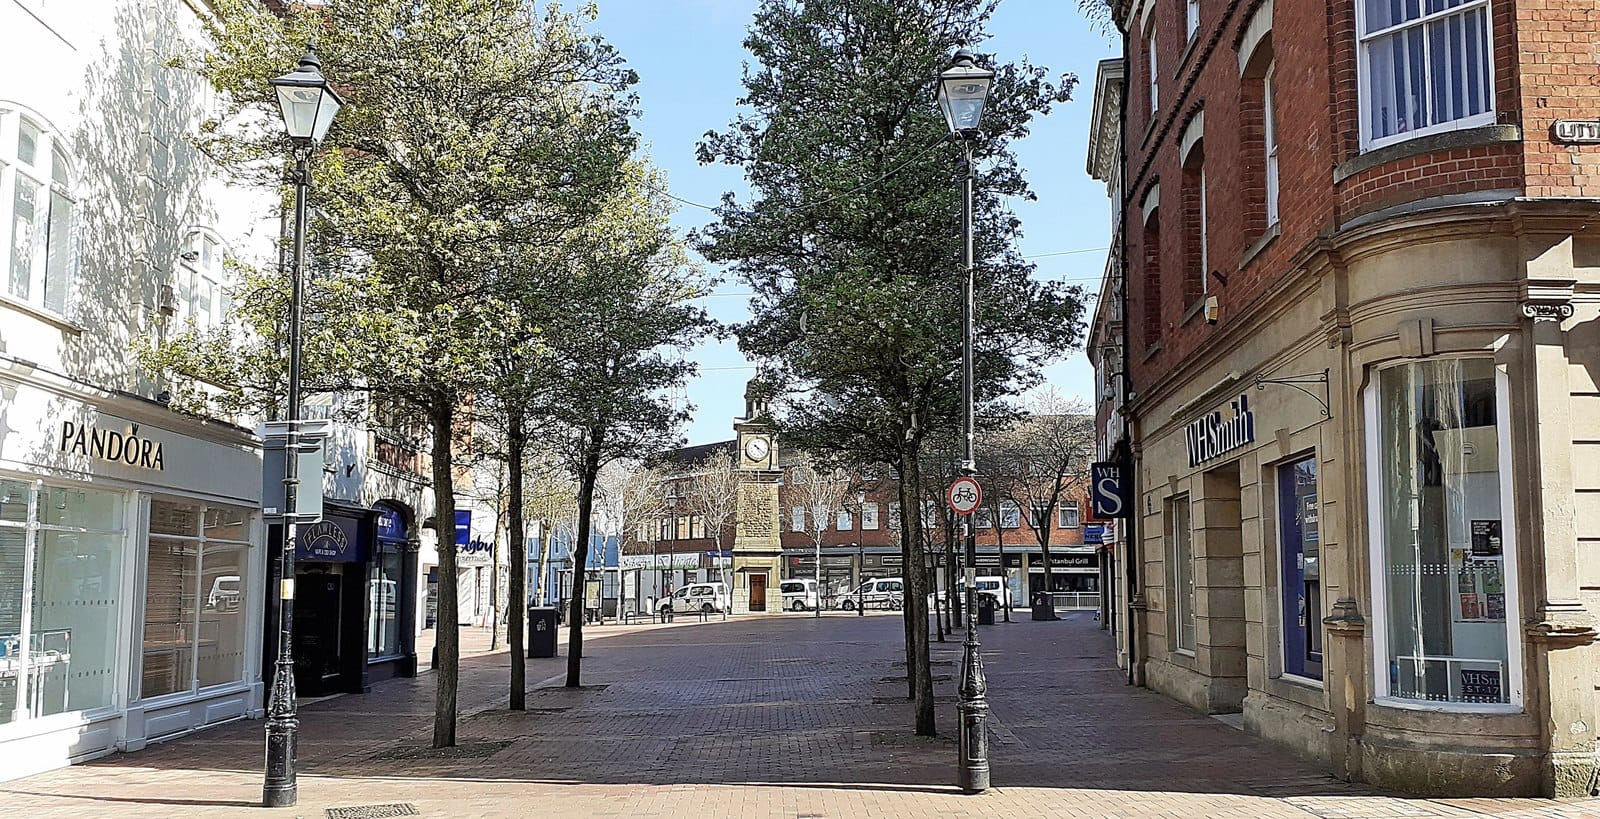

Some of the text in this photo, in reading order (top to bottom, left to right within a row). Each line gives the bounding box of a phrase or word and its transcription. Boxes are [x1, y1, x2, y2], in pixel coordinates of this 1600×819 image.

[61, 421, 164, 470] PANDORA
[1184, 393, 1255, 469] WHSmith
[1097, 467, 1120, 478] WH
[1098, 478, 1122, 515] S
[307, 522, 345, 548] FLAWLESS
[1075, 557, 1089, 565] Grill
